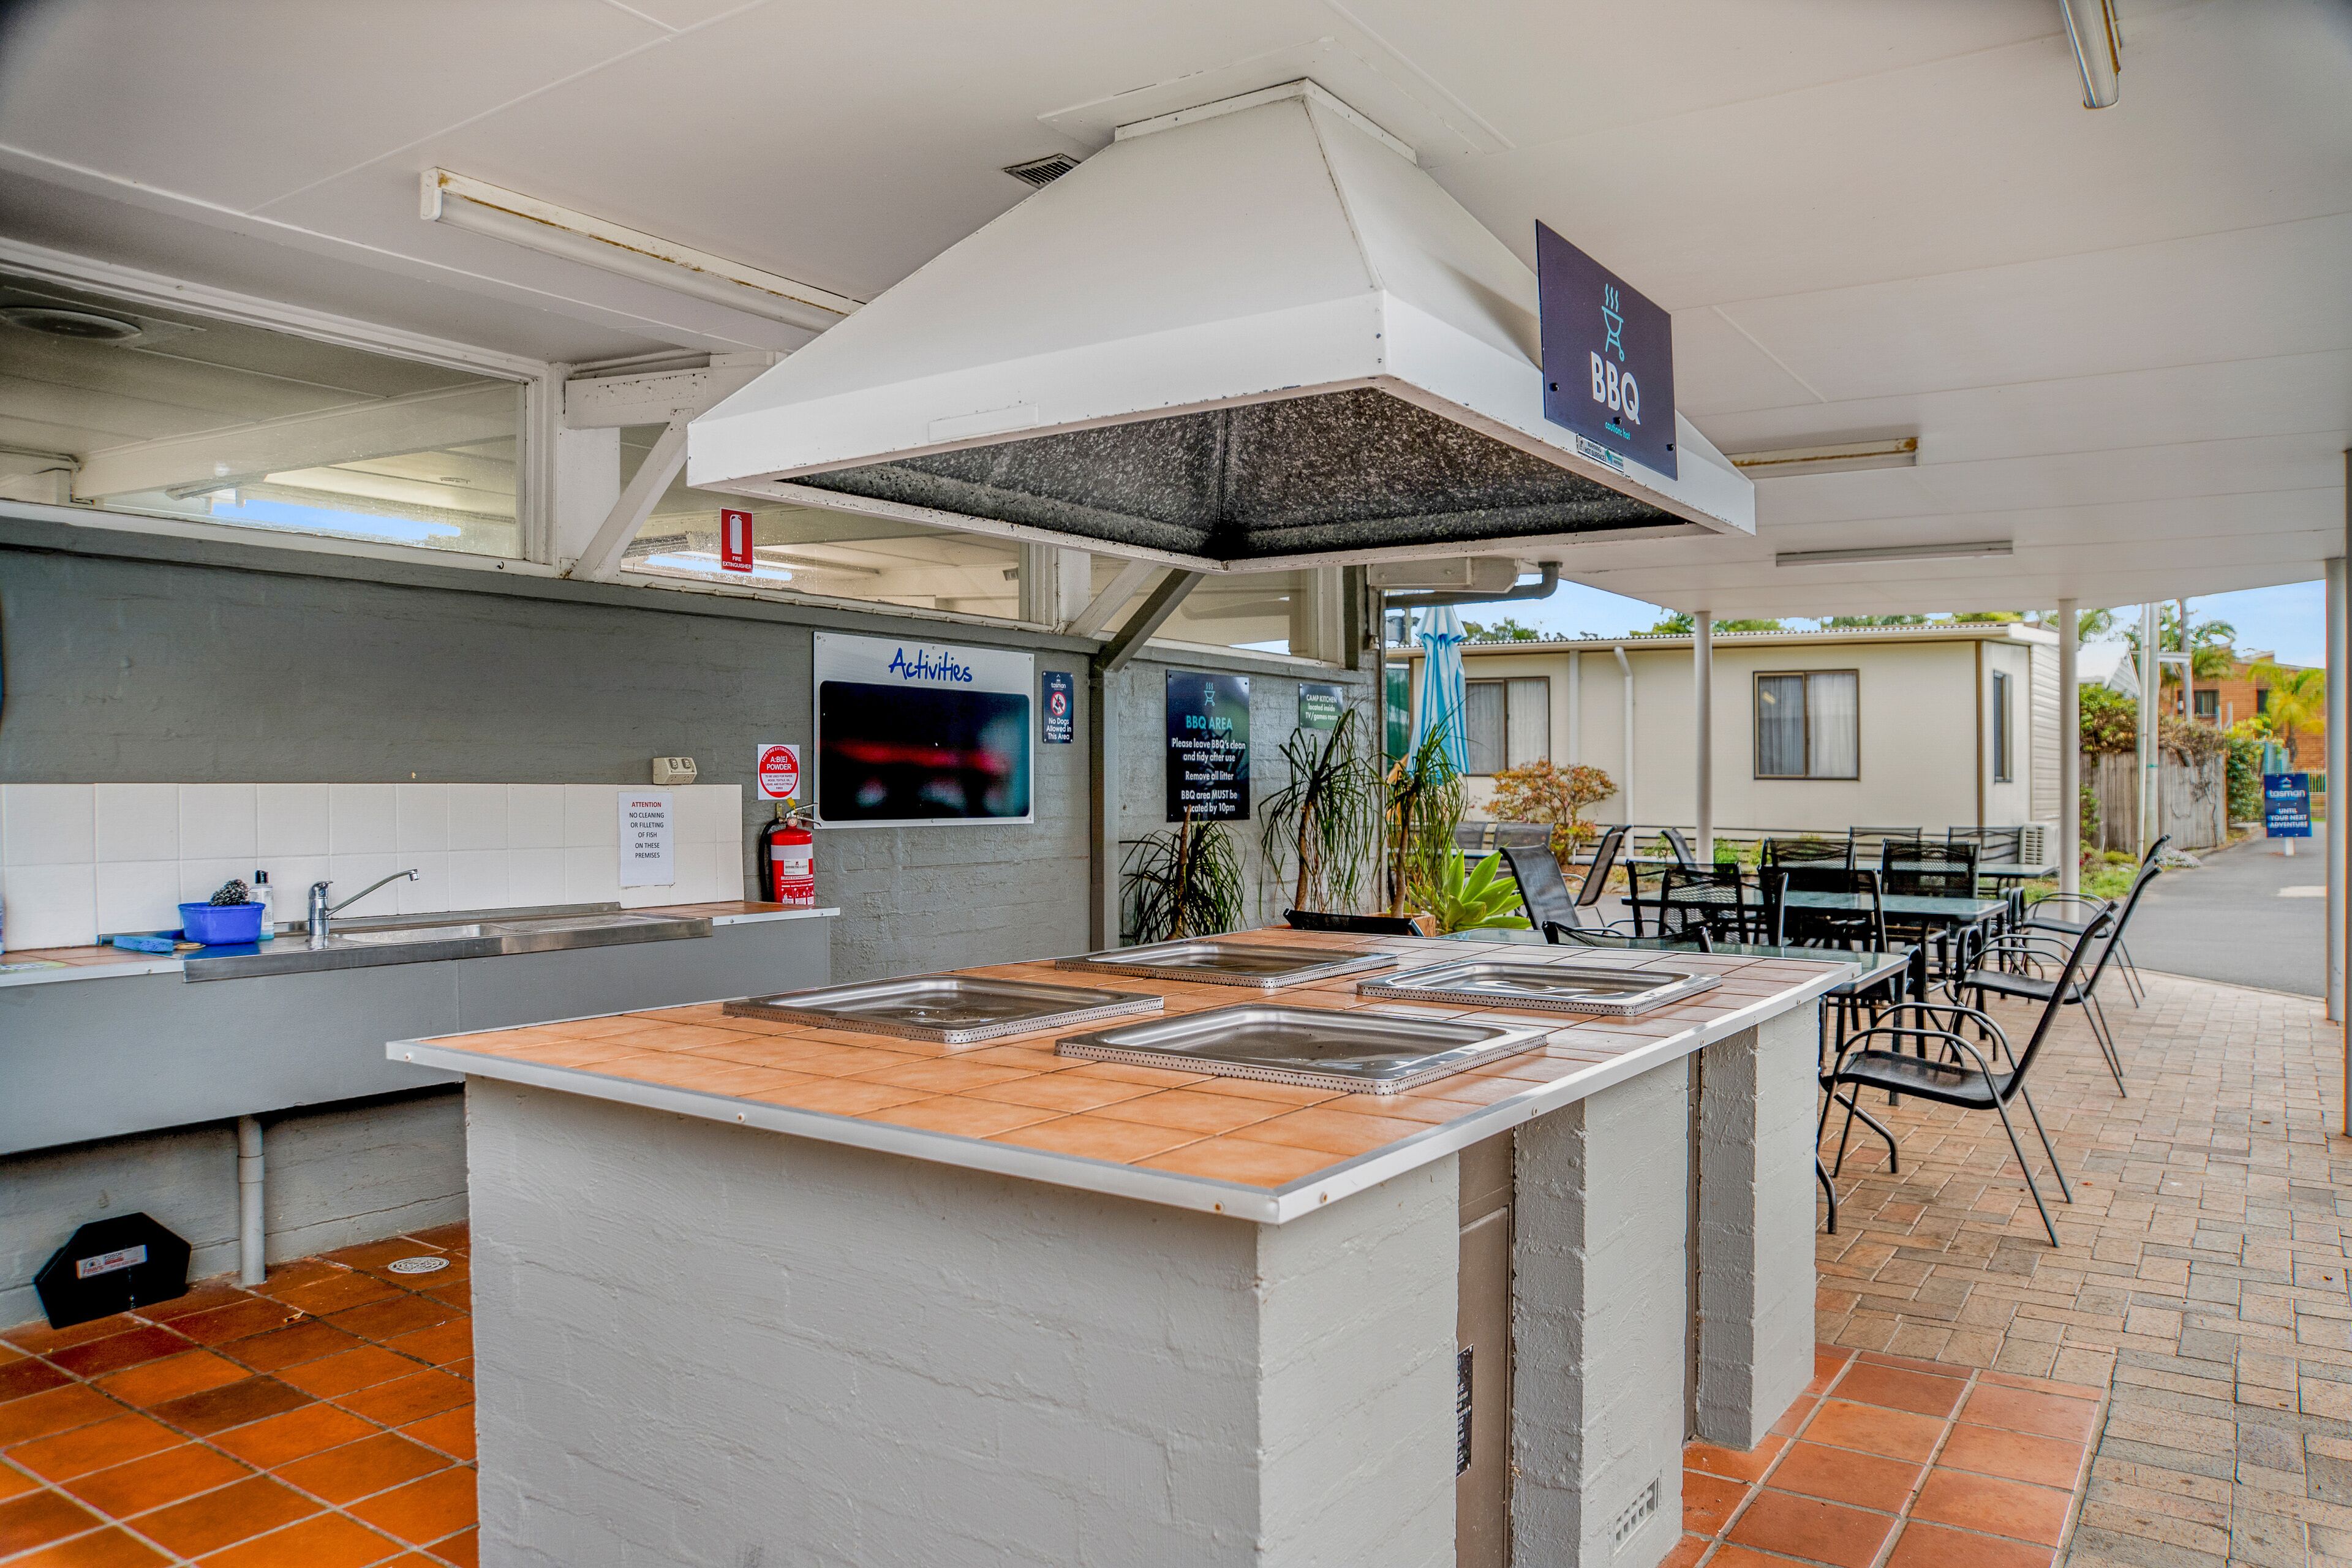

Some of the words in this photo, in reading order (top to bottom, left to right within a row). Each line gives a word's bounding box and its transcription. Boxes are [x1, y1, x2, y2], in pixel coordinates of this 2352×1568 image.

[1591, 351, 1640, 424] BBQ
[1605, 421, 1623, 437] caution:
[888, 647, 973, 682] Activities
[1057, 718, 1069, 726] Dogs
[1186, 715, 1207, 729] BBQ
[1209, 717, 1233, 730] AREA
[1305, 712, 1327, 721] TV/games
[1171, 737, 1193, 748] Please
[1194, 738, 1210, 748] leave
[1212, 739, 1229, 749] BBQ's
[1230, 741, 1246, 749] clean
[775, 747, 796, 763] EXTINGUISHER
[1183, 752, 1195, 761] and
[1196, 752, 1208, 763] tidy
[1210, 752, 1224, 762] after
[1185, 771, 1210, 780] Remove
[1219, 771, 1234, 780] litter
[1181, 790, 1195, 800] BBQ
[1212, 790, 1229, 799] MUST
[1230, 789, 1237, 799] be
[2269, 790, 2306, 798] tasman
[1183, 802, 1208, 813] vcated
[1209, 802, 1217, 814] by
[1219, 802, 1235, 814] 10pm
